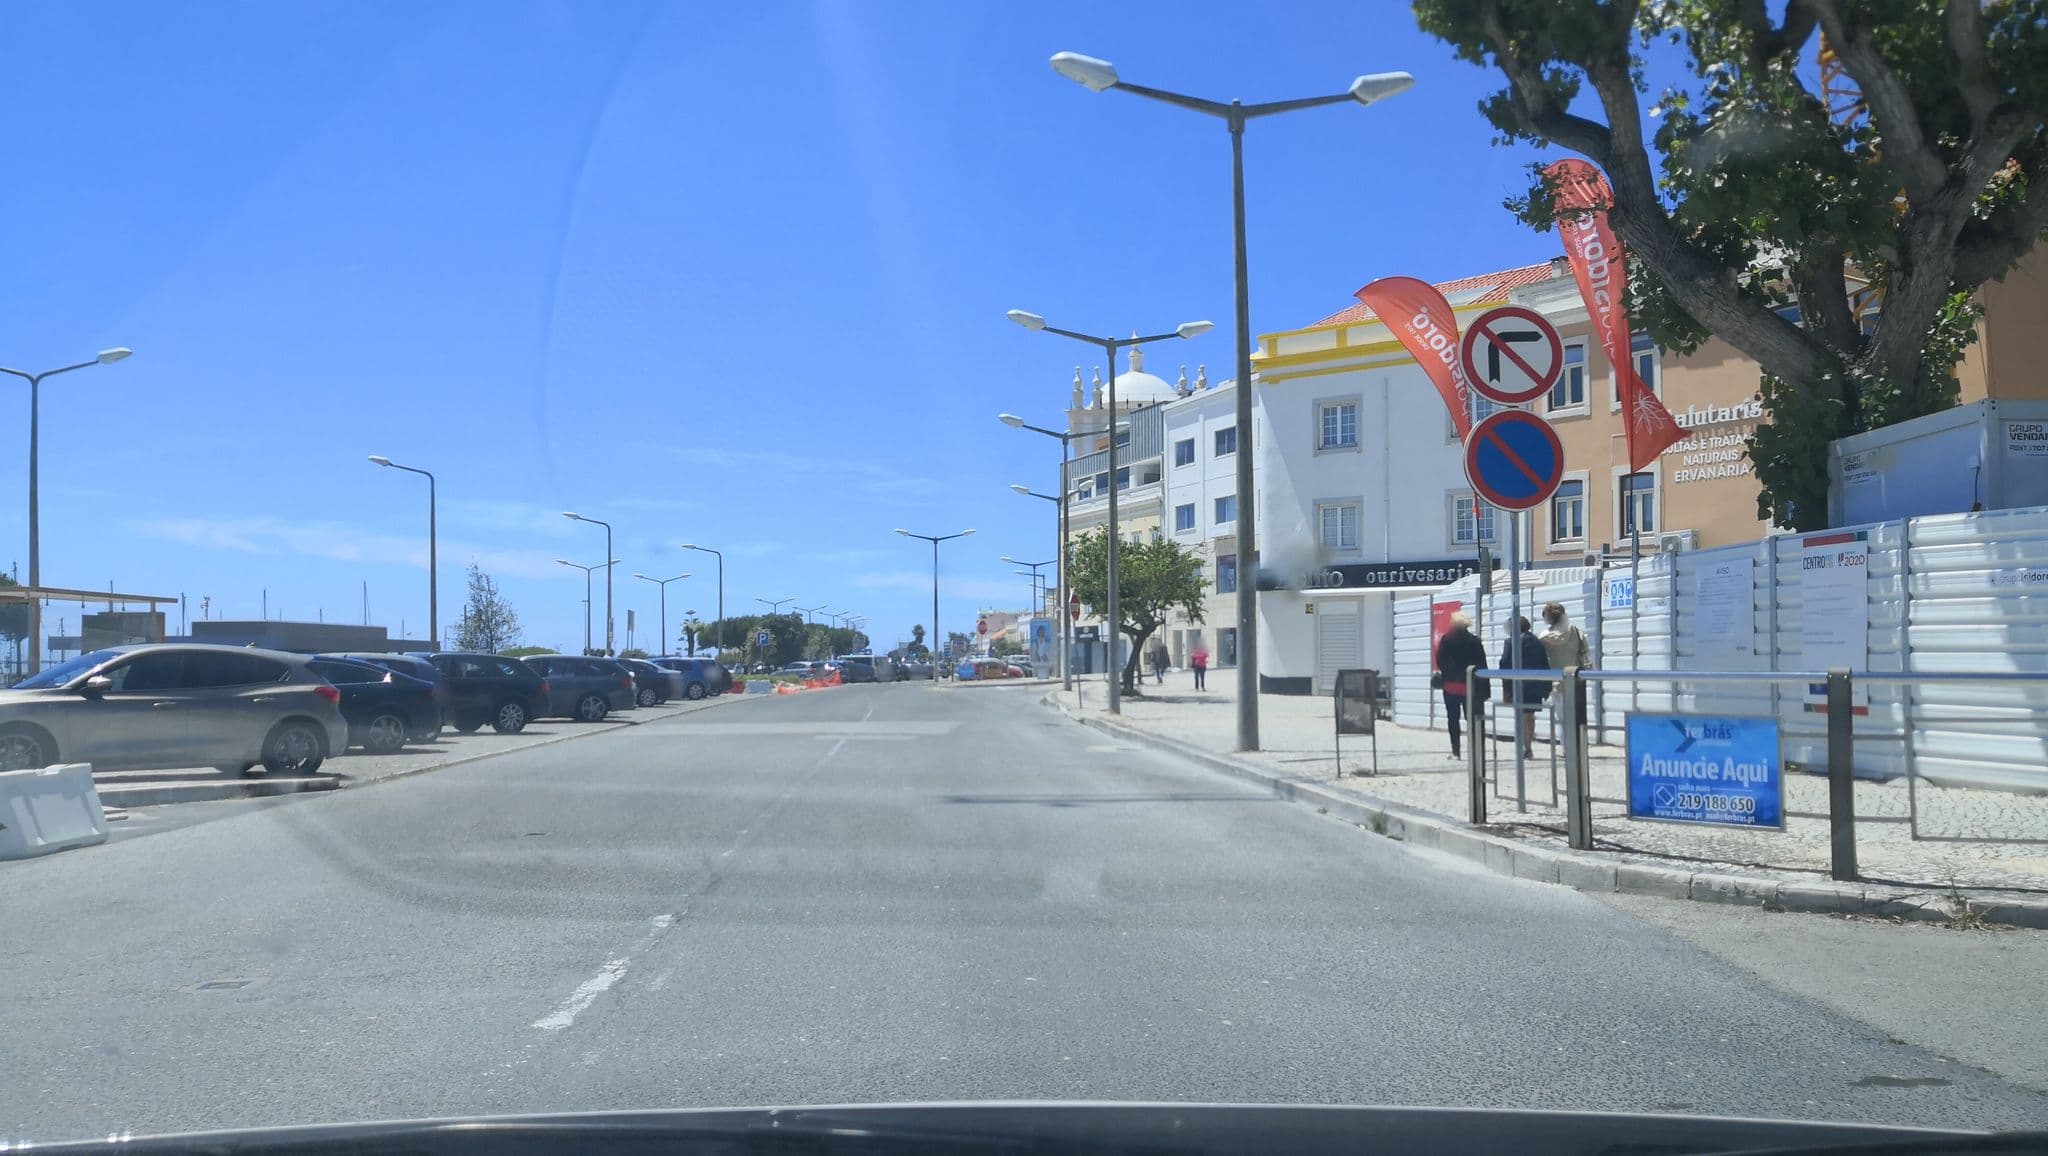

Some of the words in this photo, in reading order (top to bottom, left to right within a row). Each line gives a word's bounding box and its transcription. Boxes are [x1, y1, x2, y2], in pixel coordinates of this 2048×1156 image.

[1669, 397, 1761, 428] alutaris
[2008, 424, 2043, 433] GRUPO
[1699, 437, 1708, 450] E
[1683, 449, 1739, 466] NATURAIS
[1674, 463, 1750, 483] ERVANÁRIA
[1802, 555, 1826, 571] CENTRO
[1844, 554, 1866, 567] 2020
[1365, 563, 1474, 584] ourivesaria
[1641, 752, 1719, 780] Anuncie
[1722, 756, 1768, 788] Aqui
[1678, 792, 1703, 809] 219
[1704, 794, 1728, 811] 188
[1729, 796, 1755, 814] 650
